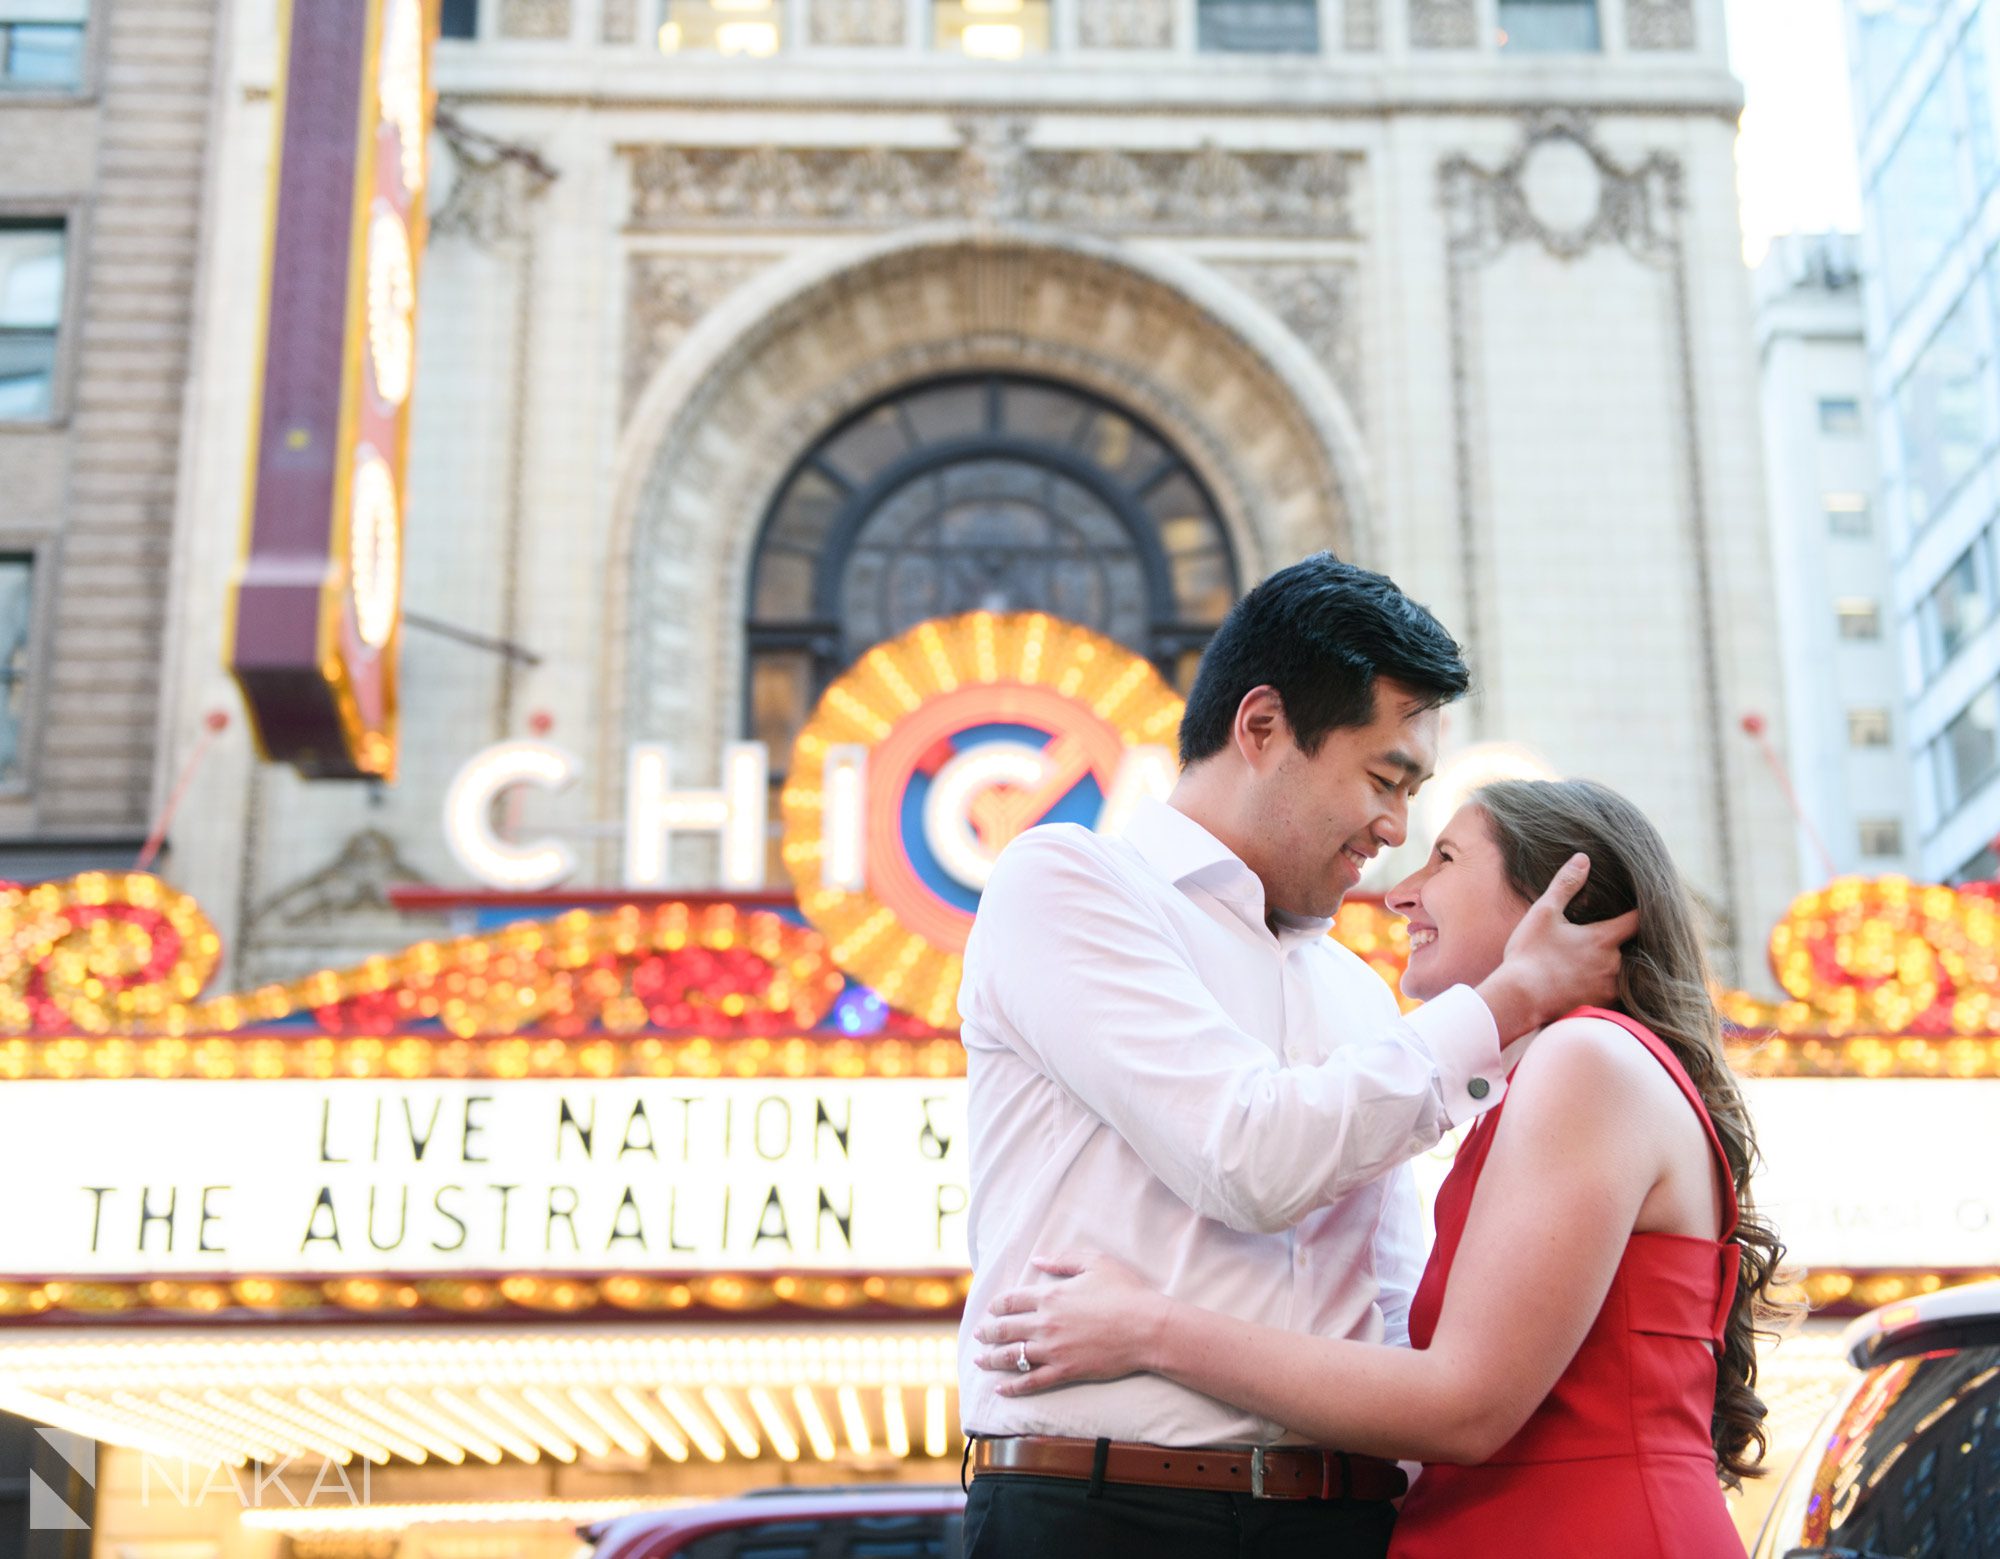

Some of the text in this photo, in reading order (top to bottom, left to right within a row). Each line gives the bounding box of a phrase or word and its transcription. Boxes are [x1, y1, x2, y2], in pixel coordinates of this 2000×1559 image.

[318, 1095, 952, 1163] LIVE NATION &
[80, 1184, 232, 1253] THE
[298, 1183, 854, 1254] AUSTRALIAN
